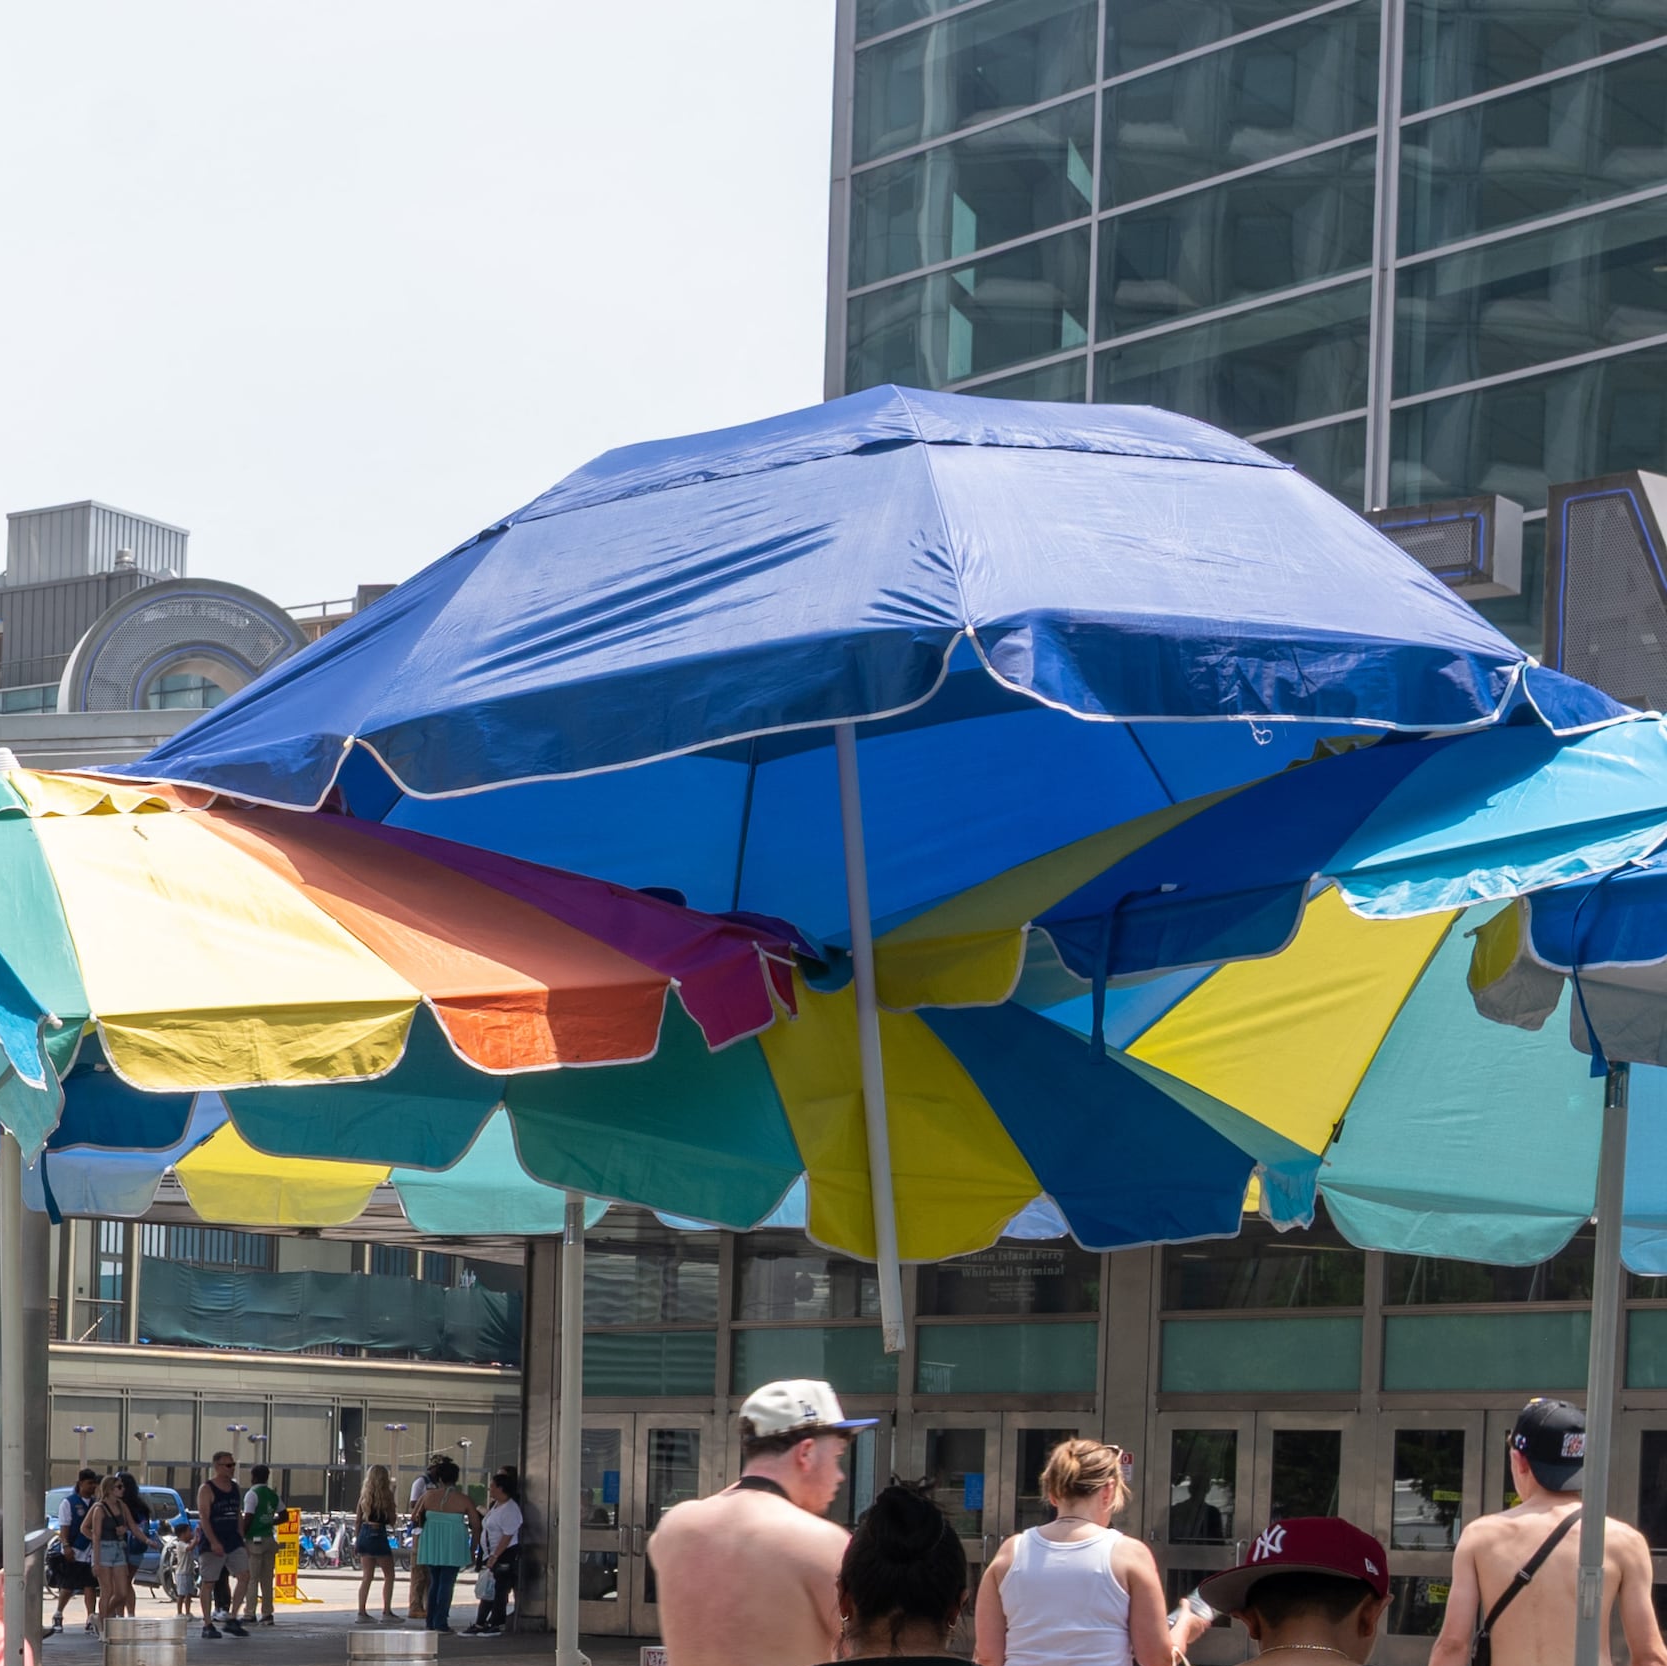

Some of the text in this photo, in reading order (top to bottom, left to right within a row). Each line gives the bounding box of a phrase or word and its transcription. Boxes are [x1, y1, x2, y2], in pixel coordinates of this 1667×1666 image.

[999, 1250, 1033, 1261] Island
[1036, 1250, 1064, 1262] Ferry
[962, 1264, 1065, 1277] Whitehall Terminal
[1252, 1524, 1287, 1562] NY
